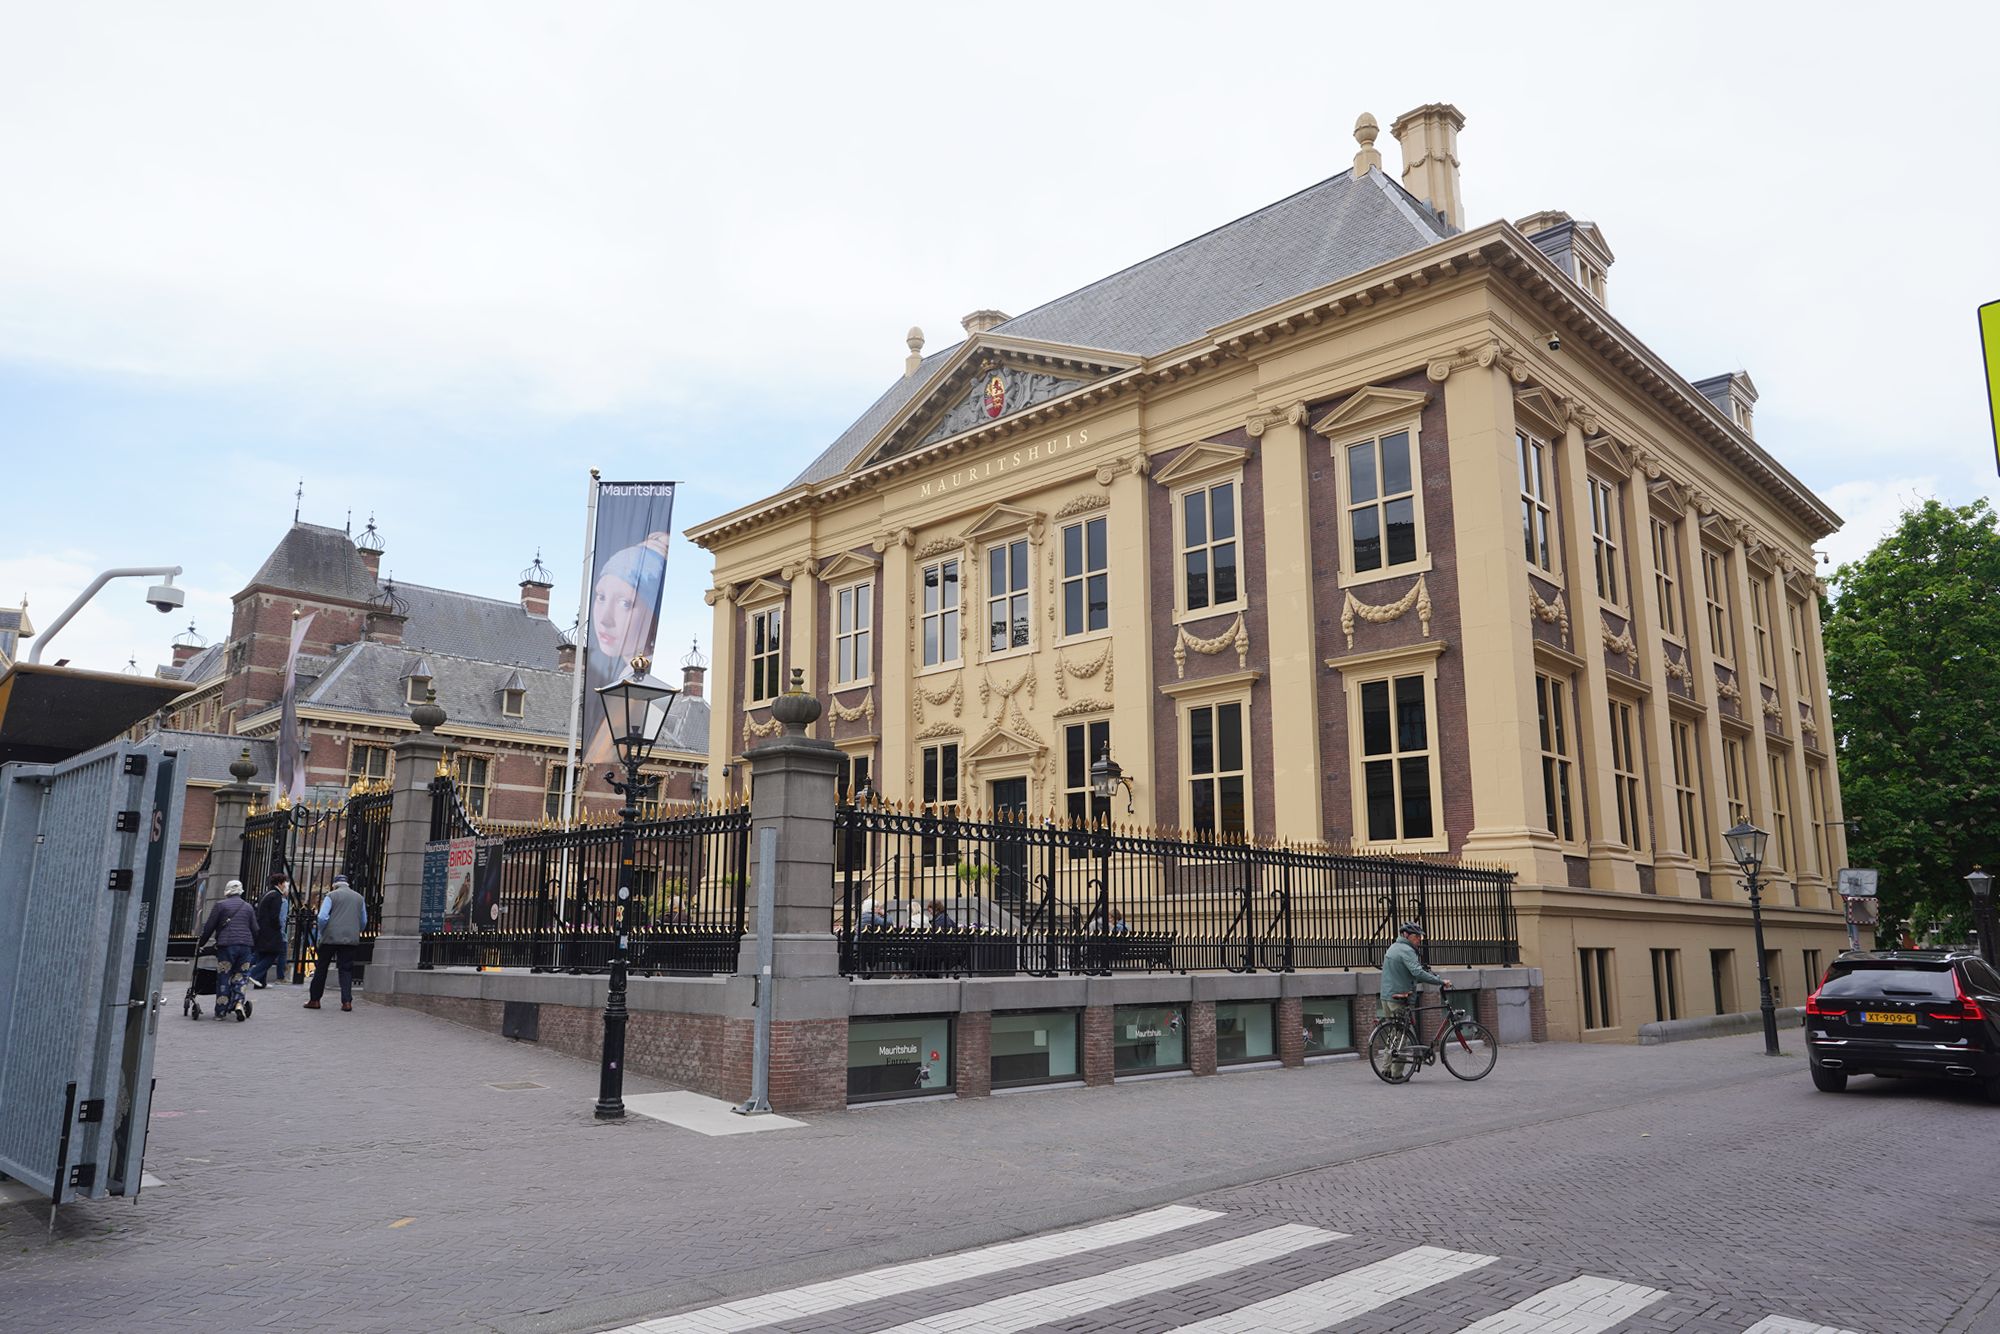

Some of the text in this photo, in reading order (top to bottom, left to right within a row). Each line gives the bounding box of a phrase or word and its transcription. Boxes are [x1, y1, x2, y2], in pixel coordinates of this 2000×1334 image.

[920, 429, 1089, 497] MAURITSHUIS
[601, 484, 672, 496] Mauritshuis
[449, 849, 473, 867] BIRDS
[1868, 1013, 1914, 1023] XT-909-G
[879, 1044, 918, 1055] Mauritshuis
